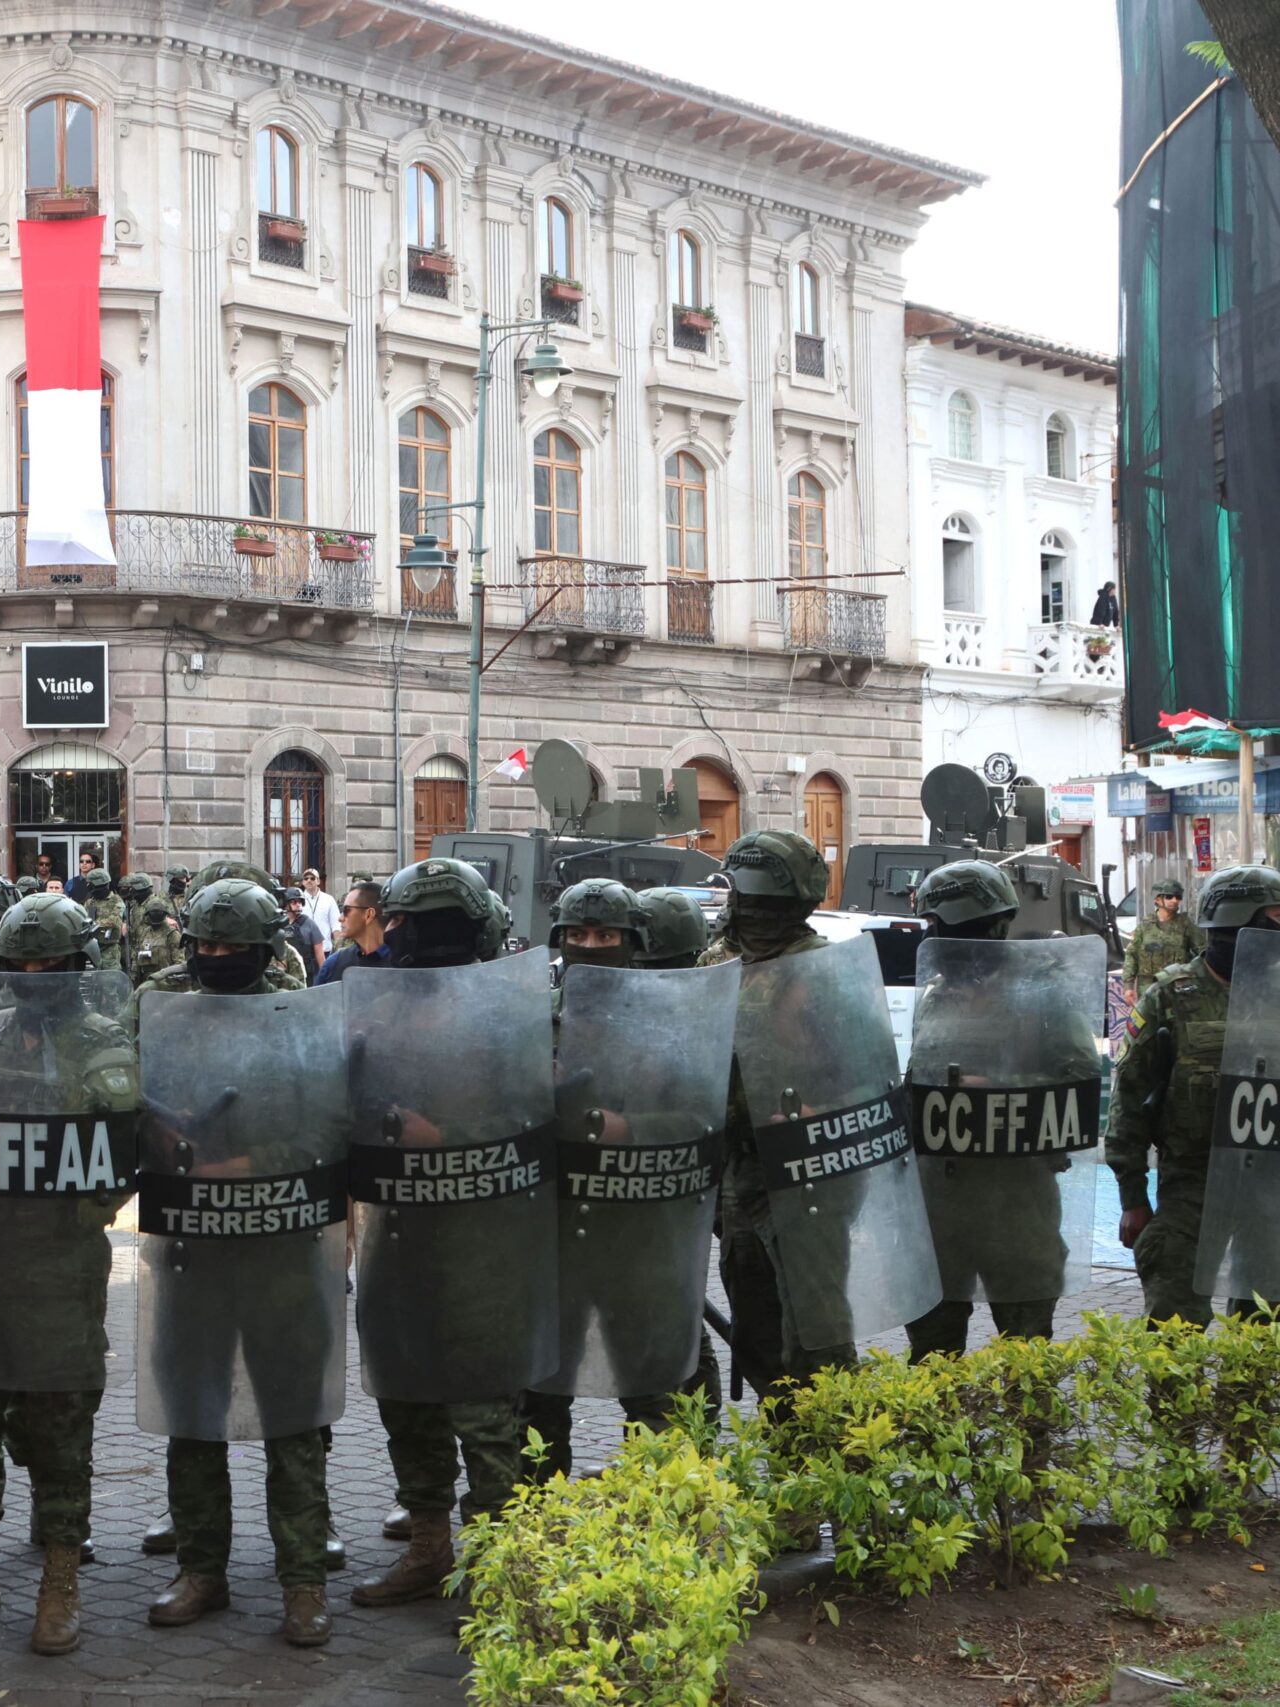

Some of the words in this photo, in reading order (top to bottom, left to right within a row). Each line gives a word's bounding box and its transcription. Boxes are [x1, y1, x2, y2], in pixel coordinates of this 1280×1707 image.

[37, 677, 94, 694] Vinilo
[1203, 780, 1257, 796] Hor
[806, 1100, 894, 1145] FUERZA
[403, 1142, 520, 1176] FUERZA
[599, 1146, 699, 1173] FUERZA
[784, 1125, 908, 1182] TERRESTRE
[192, 1178, 309, 1208] FUERZA
[375, 1160, 540, 1202] TERRESTRE
[568, 1165, 712, 1199] TERRESTRE
[162, 1199, 330, 1235] TERRESTRE
